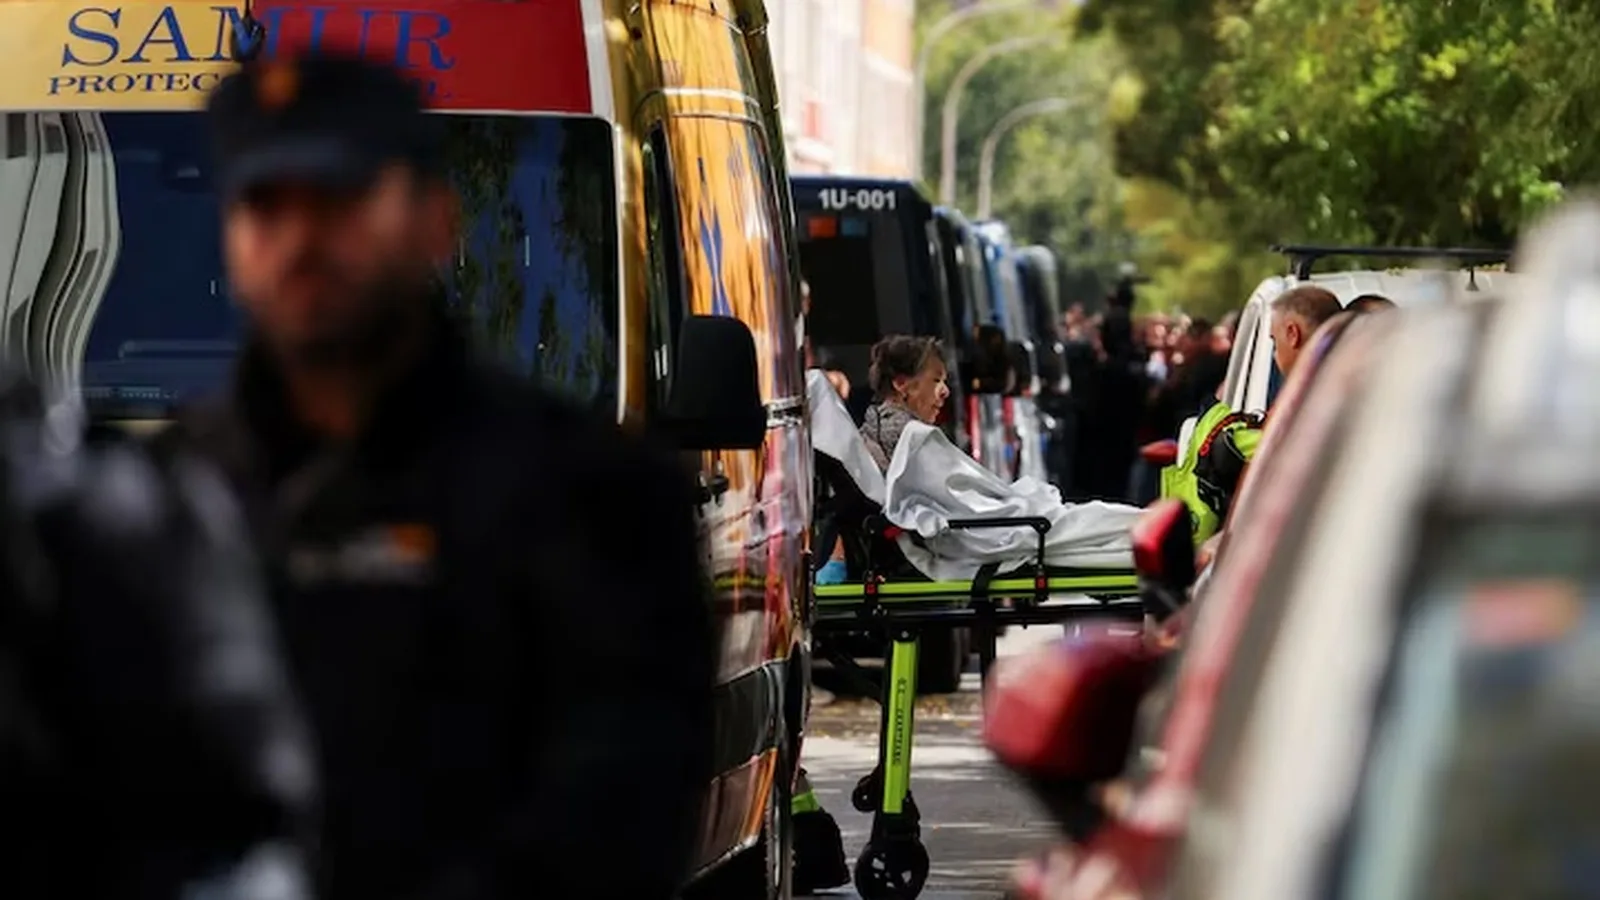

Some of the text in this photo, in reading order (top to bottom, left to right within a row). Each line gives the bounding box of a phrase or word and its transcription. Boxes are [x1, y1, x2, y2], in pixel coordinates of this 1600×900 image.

[61, 6, 456, 70] SAMUR
[47, 72, 219, 96] PROTEC
[818, 188, 896, 210] 1U-001
